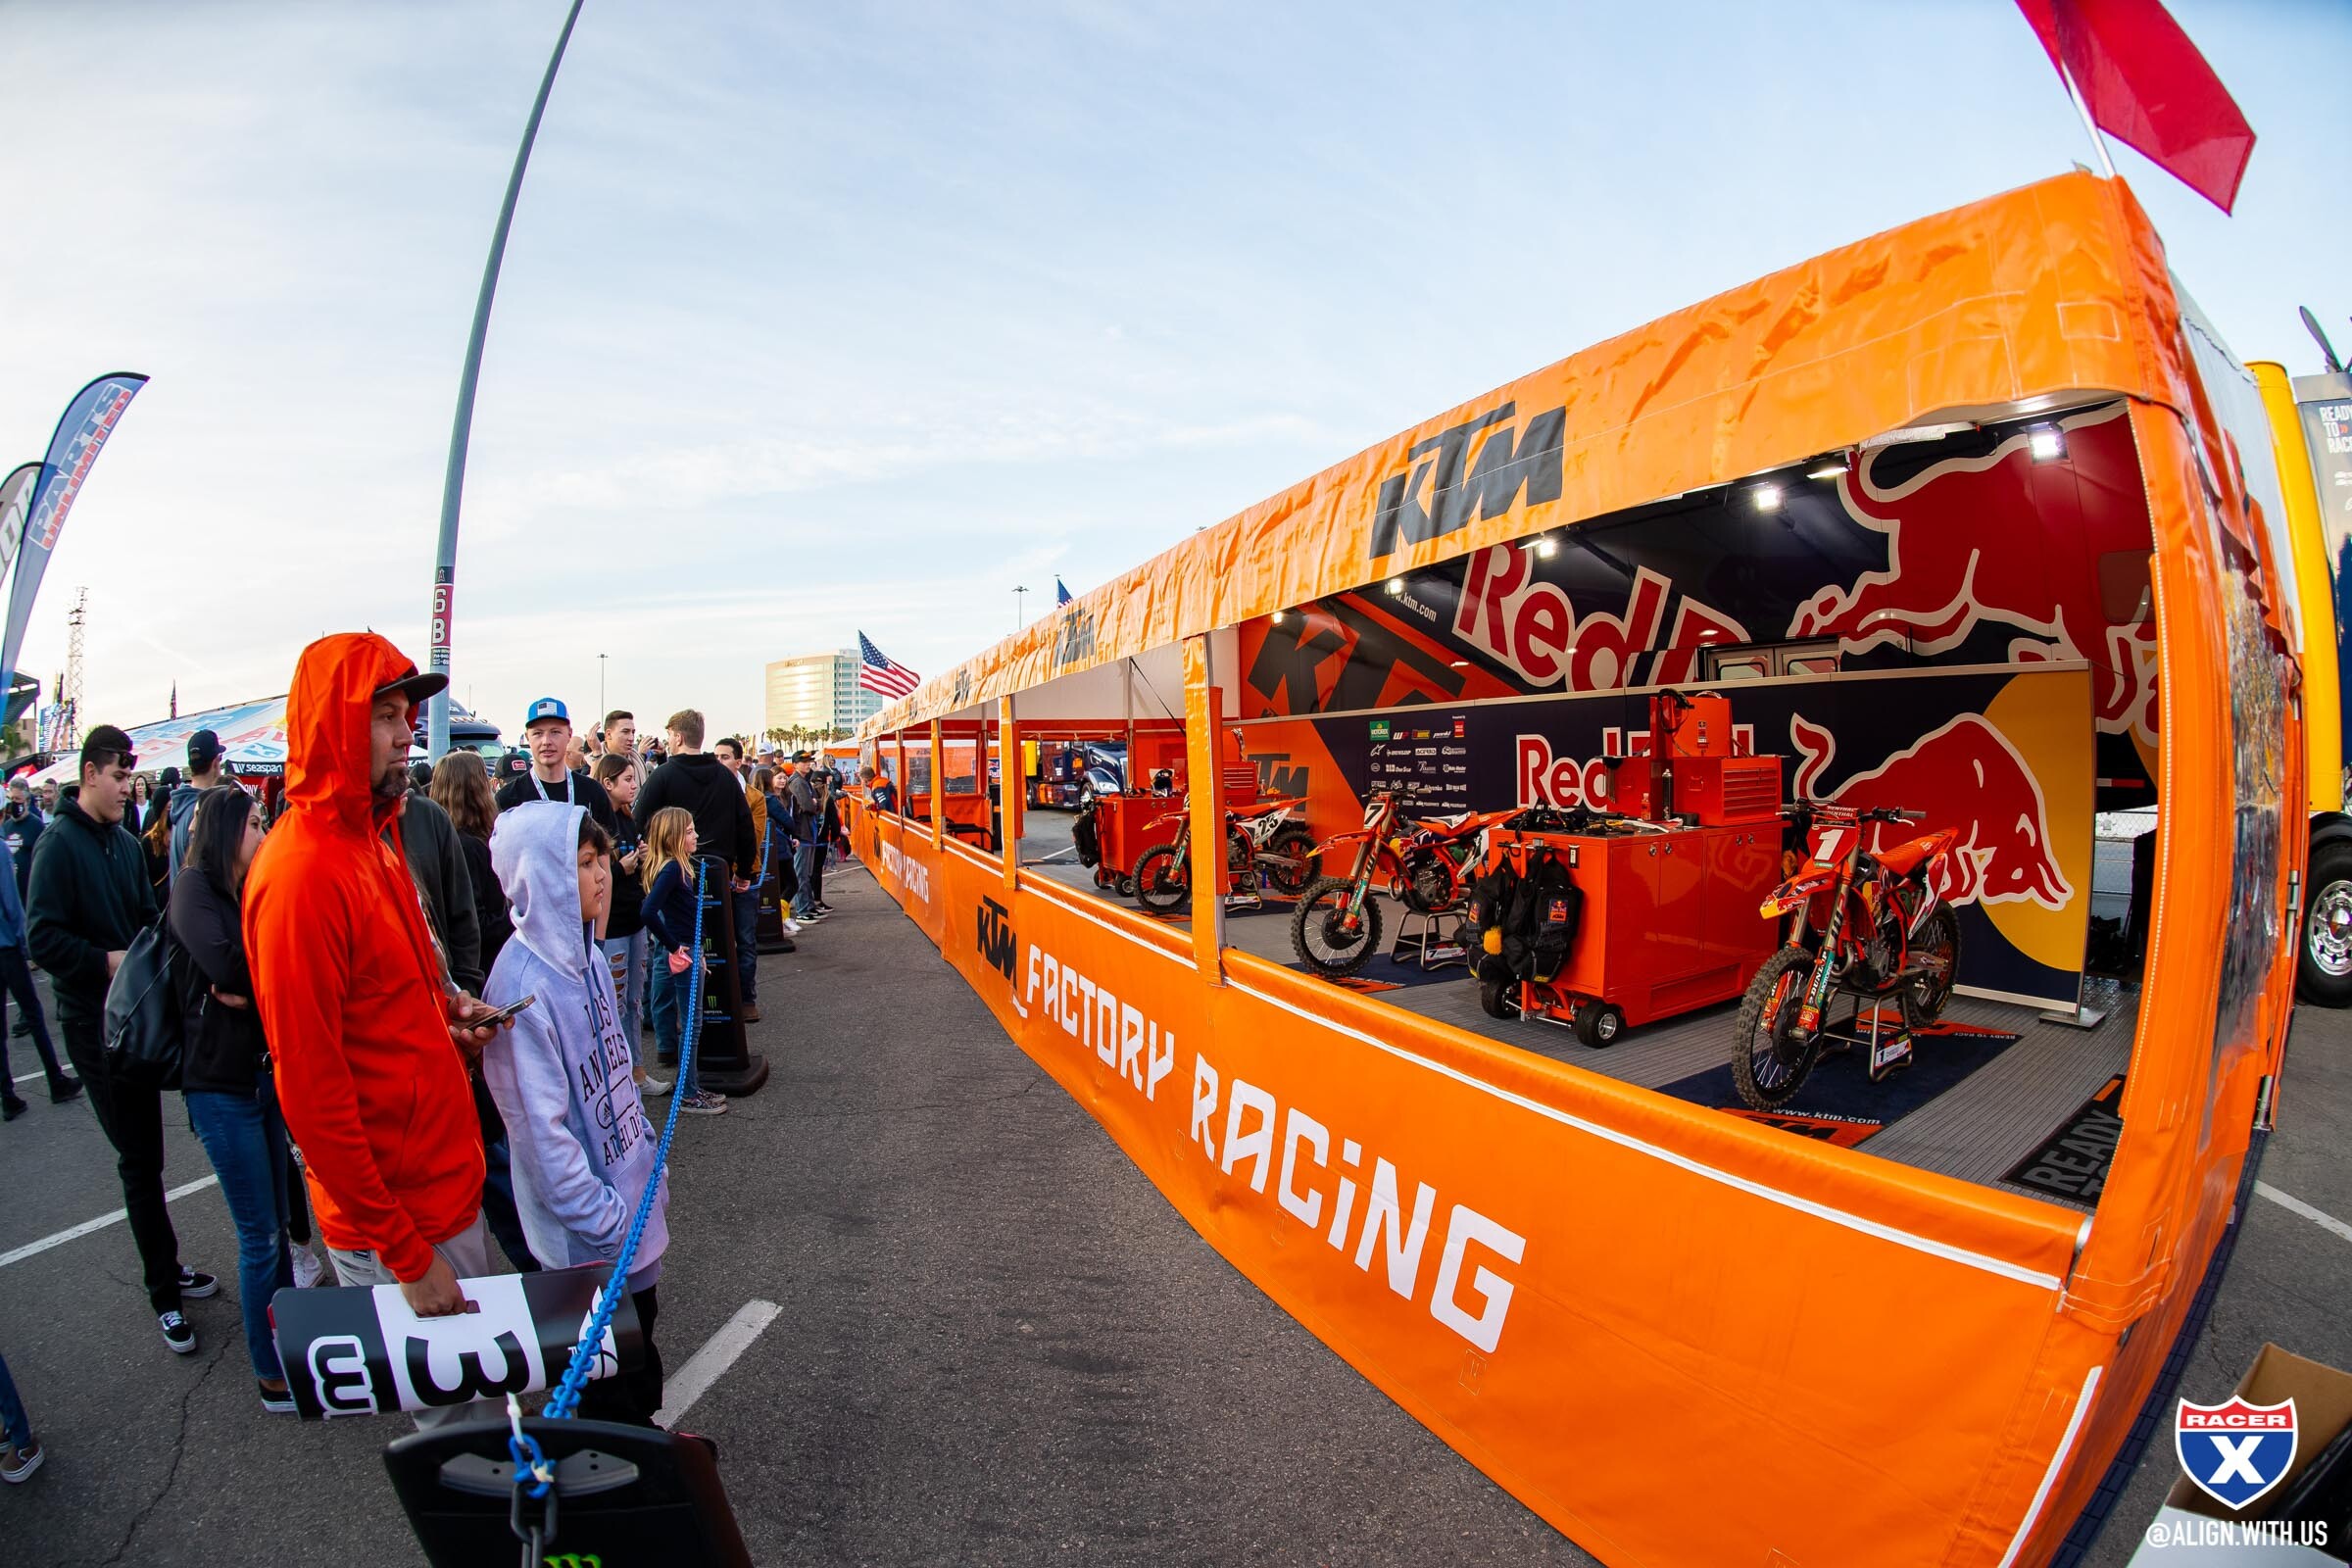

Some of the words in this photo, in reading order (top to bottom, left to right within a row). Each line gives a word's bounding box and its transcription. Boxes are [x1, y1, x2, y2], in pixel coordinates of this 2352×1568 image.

[28, 383, 123, 545] PARTS
[2324, 421, 2340, 438] TO
[42, 390, 131, 549] UNLIMITED
[1369, 400, 1567, 561] KTM
[1052, 606, 1095, 669] KTM
[246, 763, 283, 774] seaspan
[1363, 804, 1381, 827] 7
[1814, 829, 1845, 860] 1
[977, 894, 1017, 991] KTM
[1026, 943, 1175, 1102] FACTORY
[1772, 1107, 1882, 1126] www.ktm.com
[2022, 1108, 2124, 1194] READY
